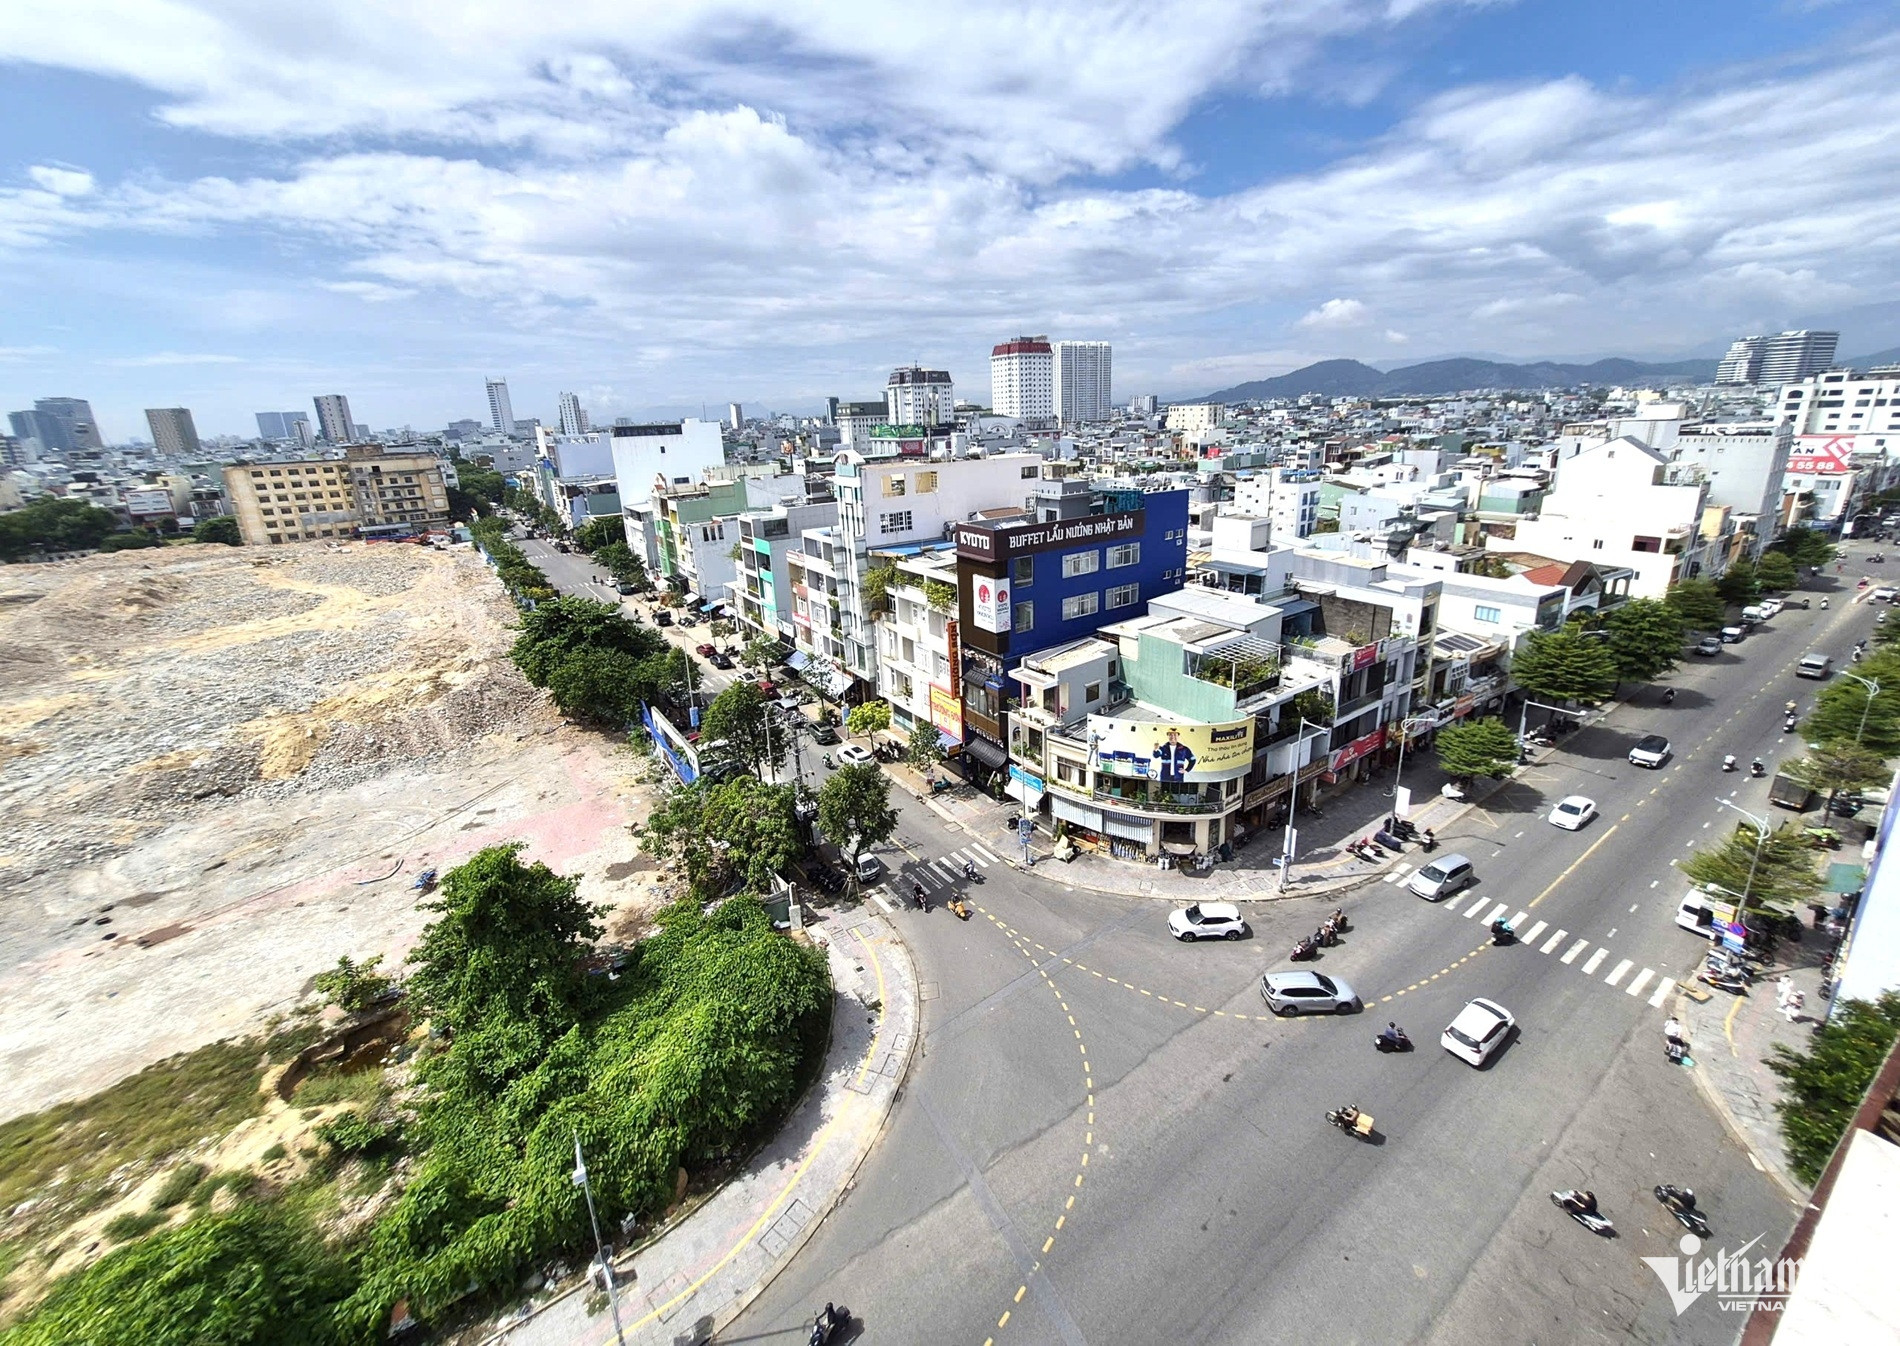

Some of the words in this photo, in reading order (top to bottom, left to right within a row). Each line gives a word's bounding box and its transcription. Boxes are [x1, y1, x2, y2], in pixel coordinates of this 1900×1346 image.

[1816, 461, 1835, 470] 88
[960, 531, 990, 550] KYOTO
[1009, 531, 1045, 549] BUFFET
[1094, 518, 1116, 535] NHẬT
[1117, 515, 1133, 530] BẢN
